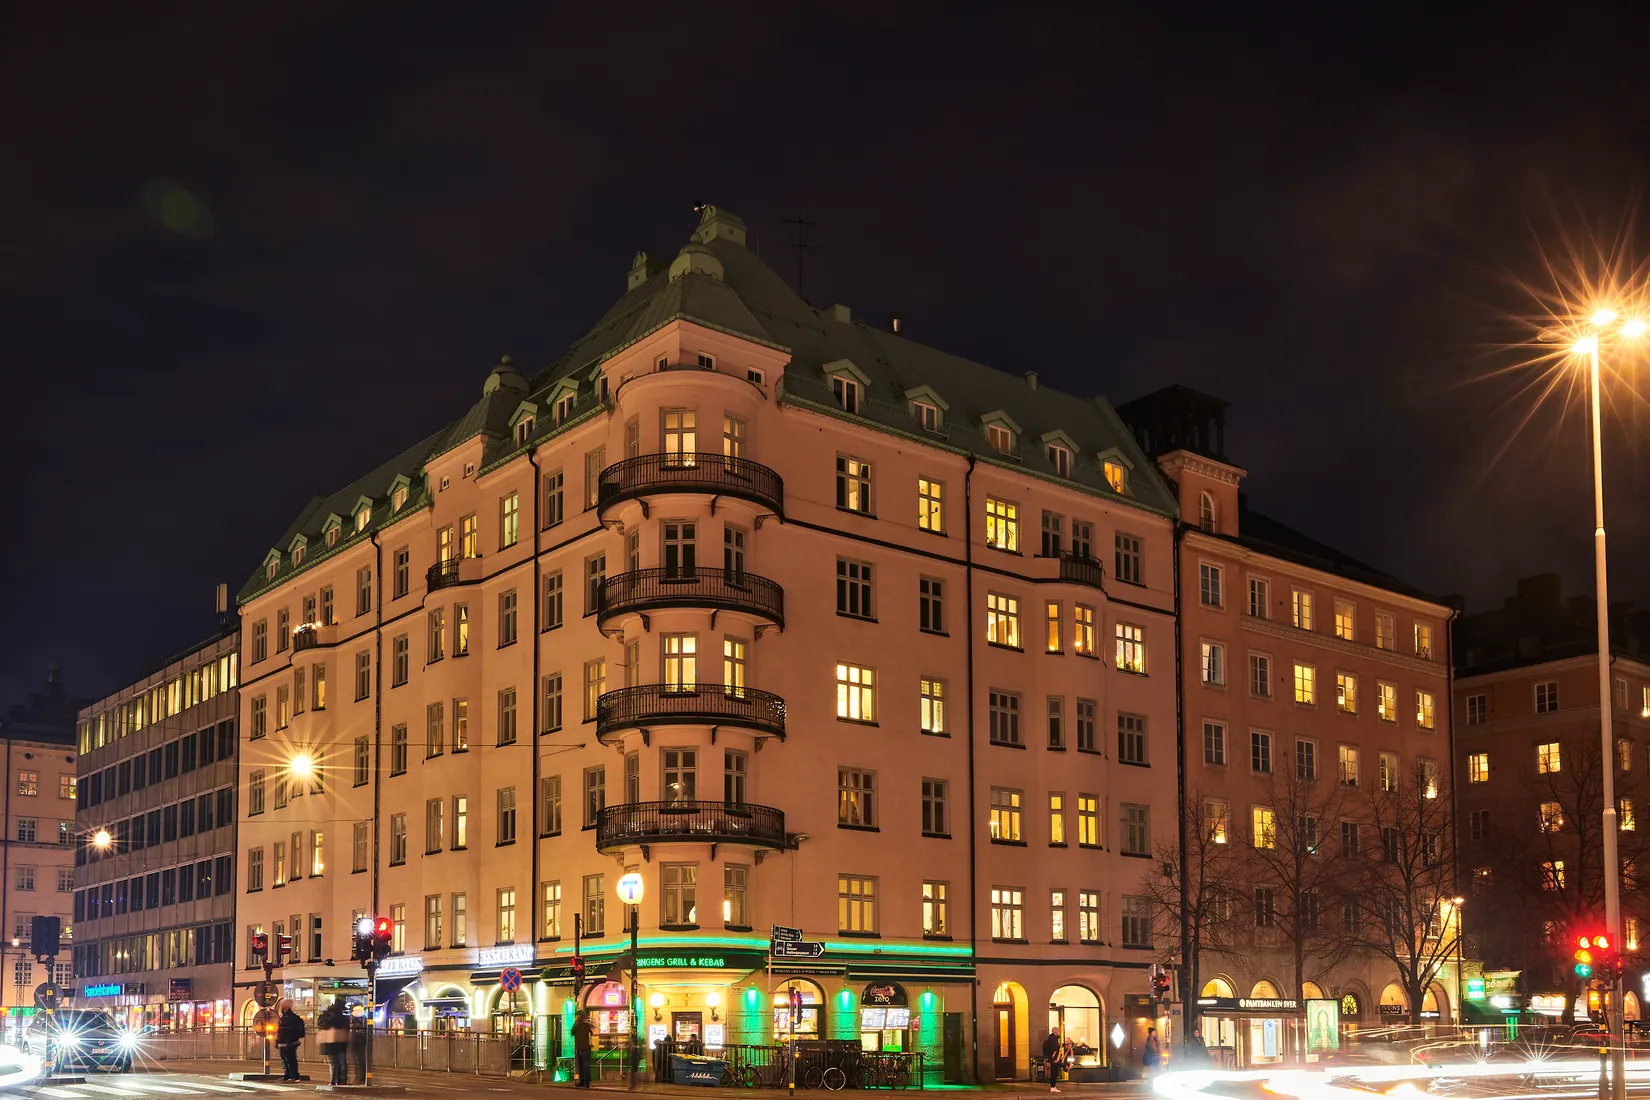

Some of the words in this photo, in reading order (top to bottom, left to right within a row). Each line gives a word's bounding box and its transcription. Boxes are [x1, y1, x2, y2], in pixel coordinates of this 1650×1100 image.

[622, 880, 638, 899] T
[479, 948, 533, 963] RESTAURANG
[666, 957, 688, 966] GRILL
[690, 957, 697, 966] &
[698, 957, 725, 967] KEBAB
[84, 983, 121, 998] Handelsbanken
[1245, 999, 1283, 1009] PANTBANKEN
